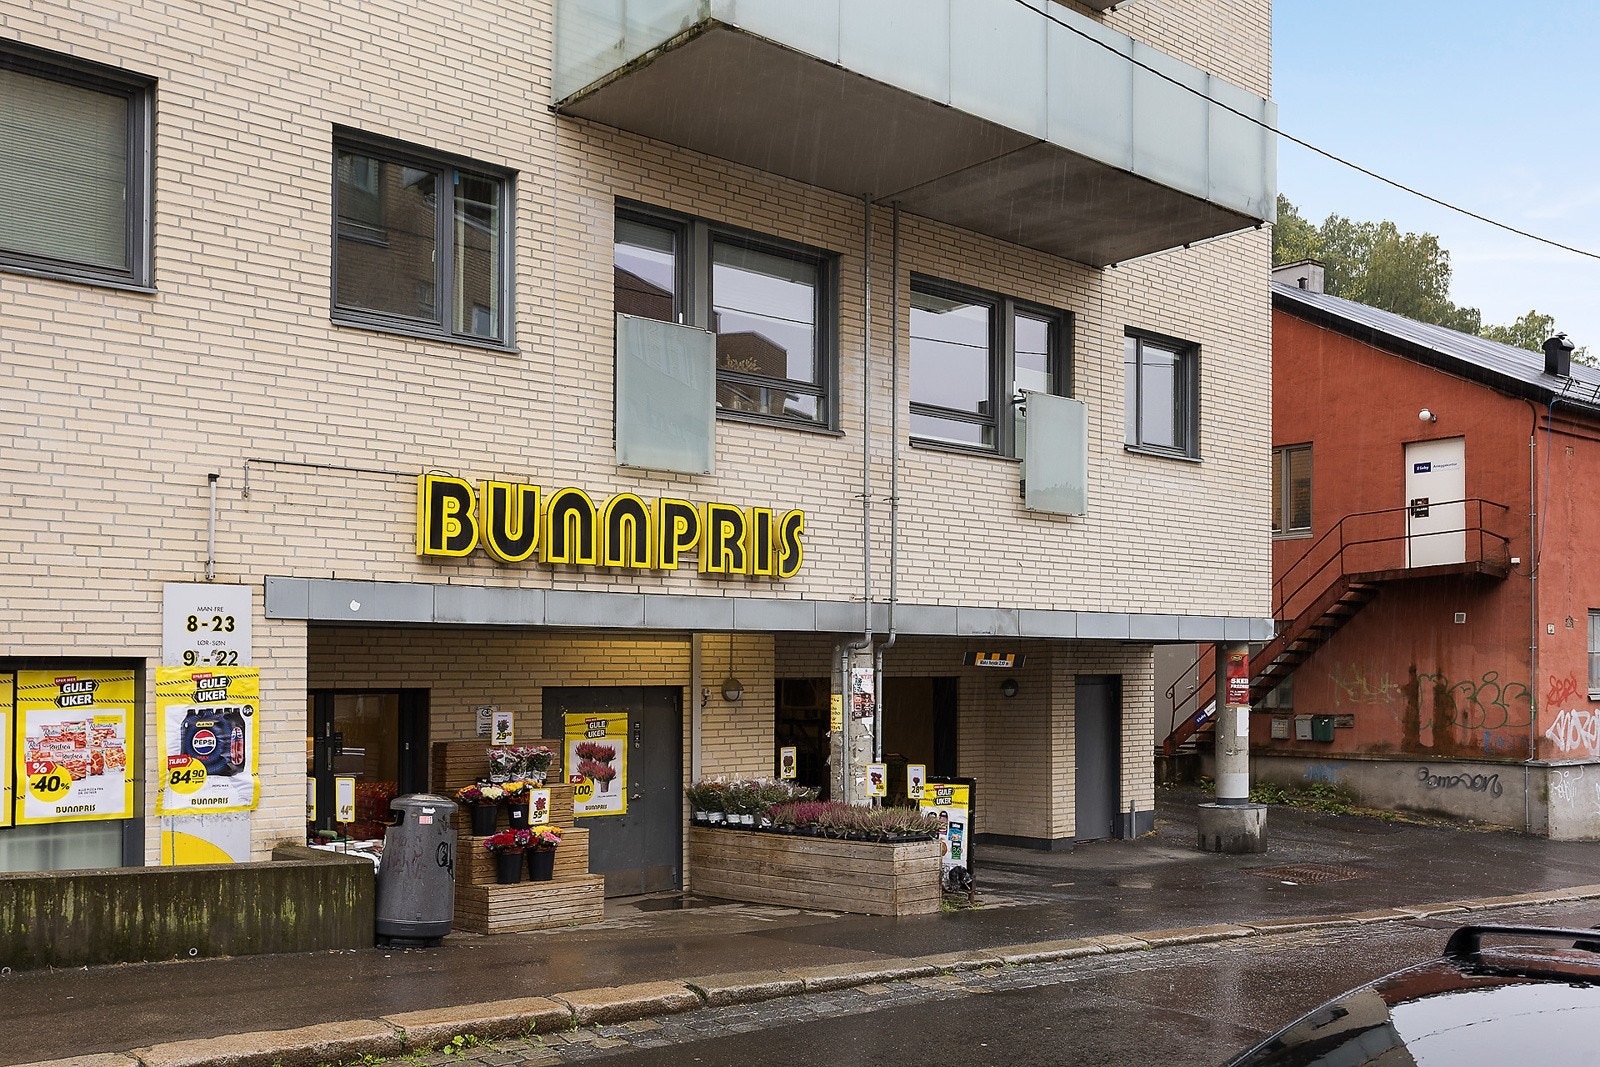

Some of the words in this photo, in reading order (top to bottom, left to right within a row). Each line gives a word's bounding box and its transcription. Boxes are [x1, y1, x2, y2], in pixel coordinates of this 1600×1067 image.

[416, 474, 805, 579] BUNNPRIS
[63, 681, 93, 693] GULE
[200, 678, 227, 688] GULE
[61, 694, 92, 706] UKER
[198, 691, 226, 701] UKER
[588, 730, 605, 738] UKER
[191, 797, 229, 805] BUNNPRIS
[56, 804, 96, 813] BUNNPRIS
